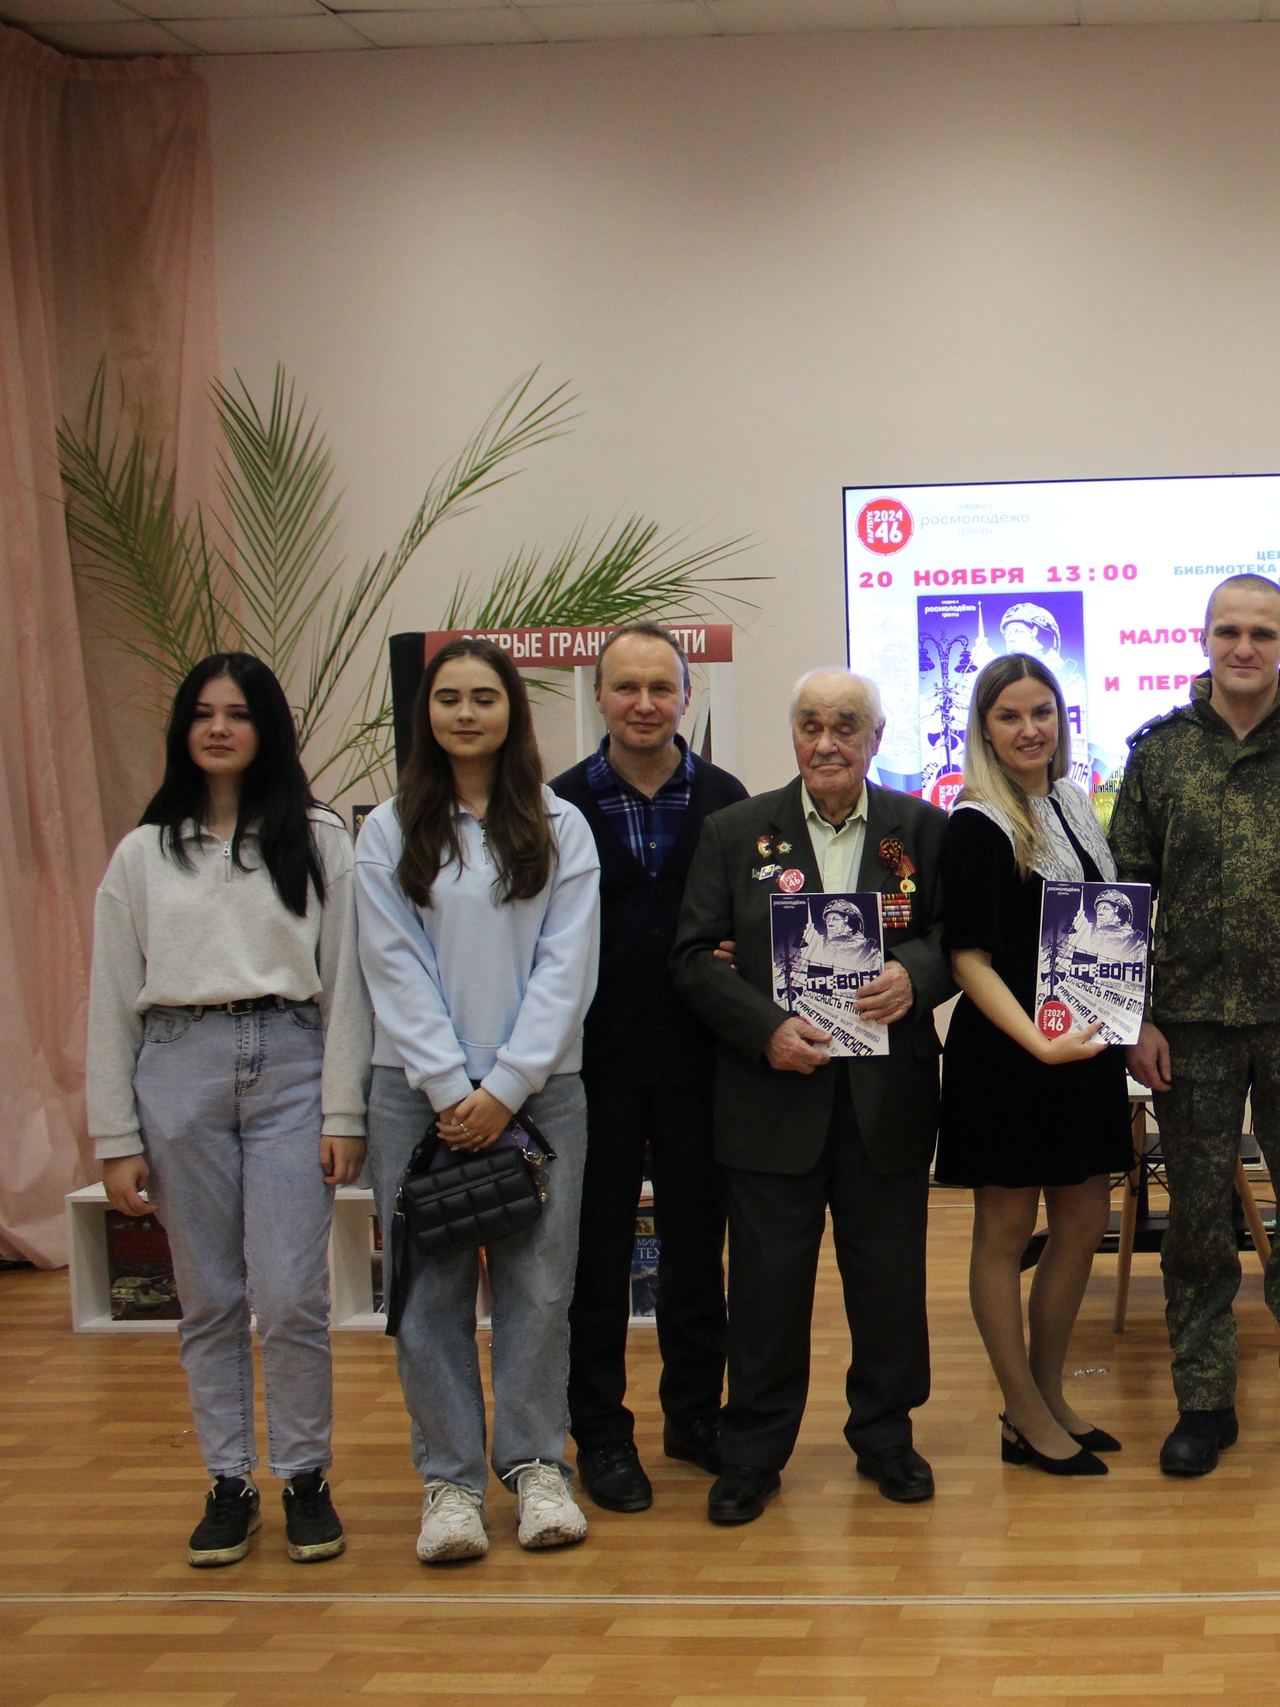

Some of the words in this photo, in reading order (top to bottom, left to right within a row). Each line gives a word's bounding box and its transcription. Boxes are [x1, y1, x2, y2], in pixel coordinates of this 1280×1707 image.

[873, 509, 903, 523] 2024
[920, 511, 1029, 530] росмолодёжь
[874, 522, 903, 544] 46
[957, 527, 993, 537] гранты
[858, 571, 893, 588] 20
[913, 566, 1024, 587] НОЯБРЯ
[1046, 563, 1138, 583] 13:00
[1173, 563, 1277, 576] БИБЛИОТЕКА
[1104, 676, 1120, 692] И
[789, 877, 801, 888] 46
[1070, 961, 1143, 983] ТРЕВОГА
[1057, 985, 1092, 1019] РАКЕТНАЯ
[1102, 990, 1128, 1009] АТАКИ
[795, 999, 834, 1032] РАКЕТНАЯ
[1047, 1009, 1066, 1018] 2024
[1047, 1017, 1064, 1032] 46
